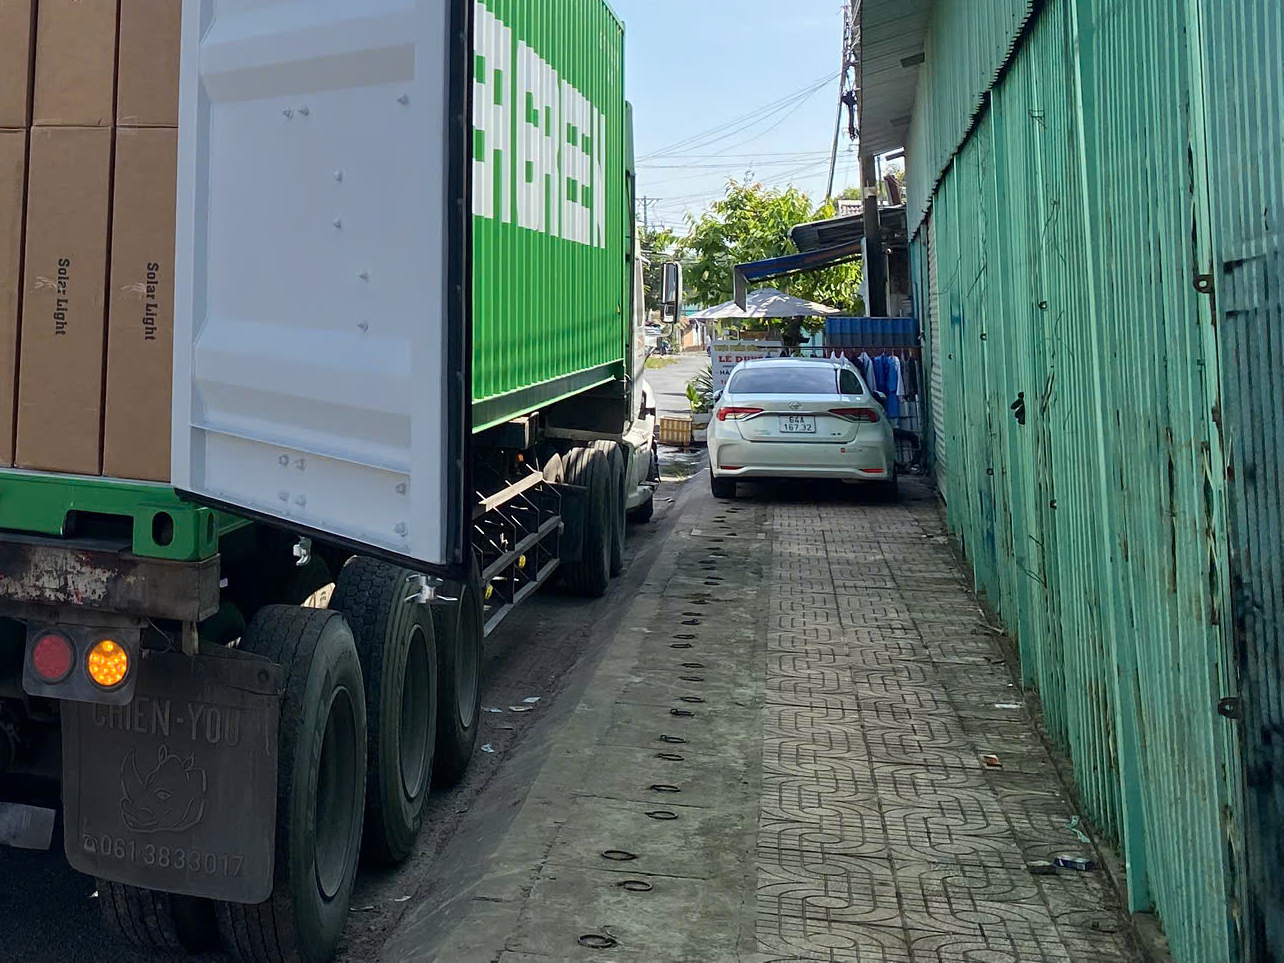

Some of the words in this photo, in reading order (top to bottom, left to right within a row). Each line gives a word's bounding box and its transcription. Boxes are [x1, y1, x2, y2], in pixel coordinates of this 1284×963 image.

[57, 258, 70, 296] Solar
[146, 262, 160, 300] Solar
[53, 298, 69, 336] Light
[142, 302, 158, 341] Light
[100, 834, 136, 862] 061
[143, 843, 246, 878] 3833017
